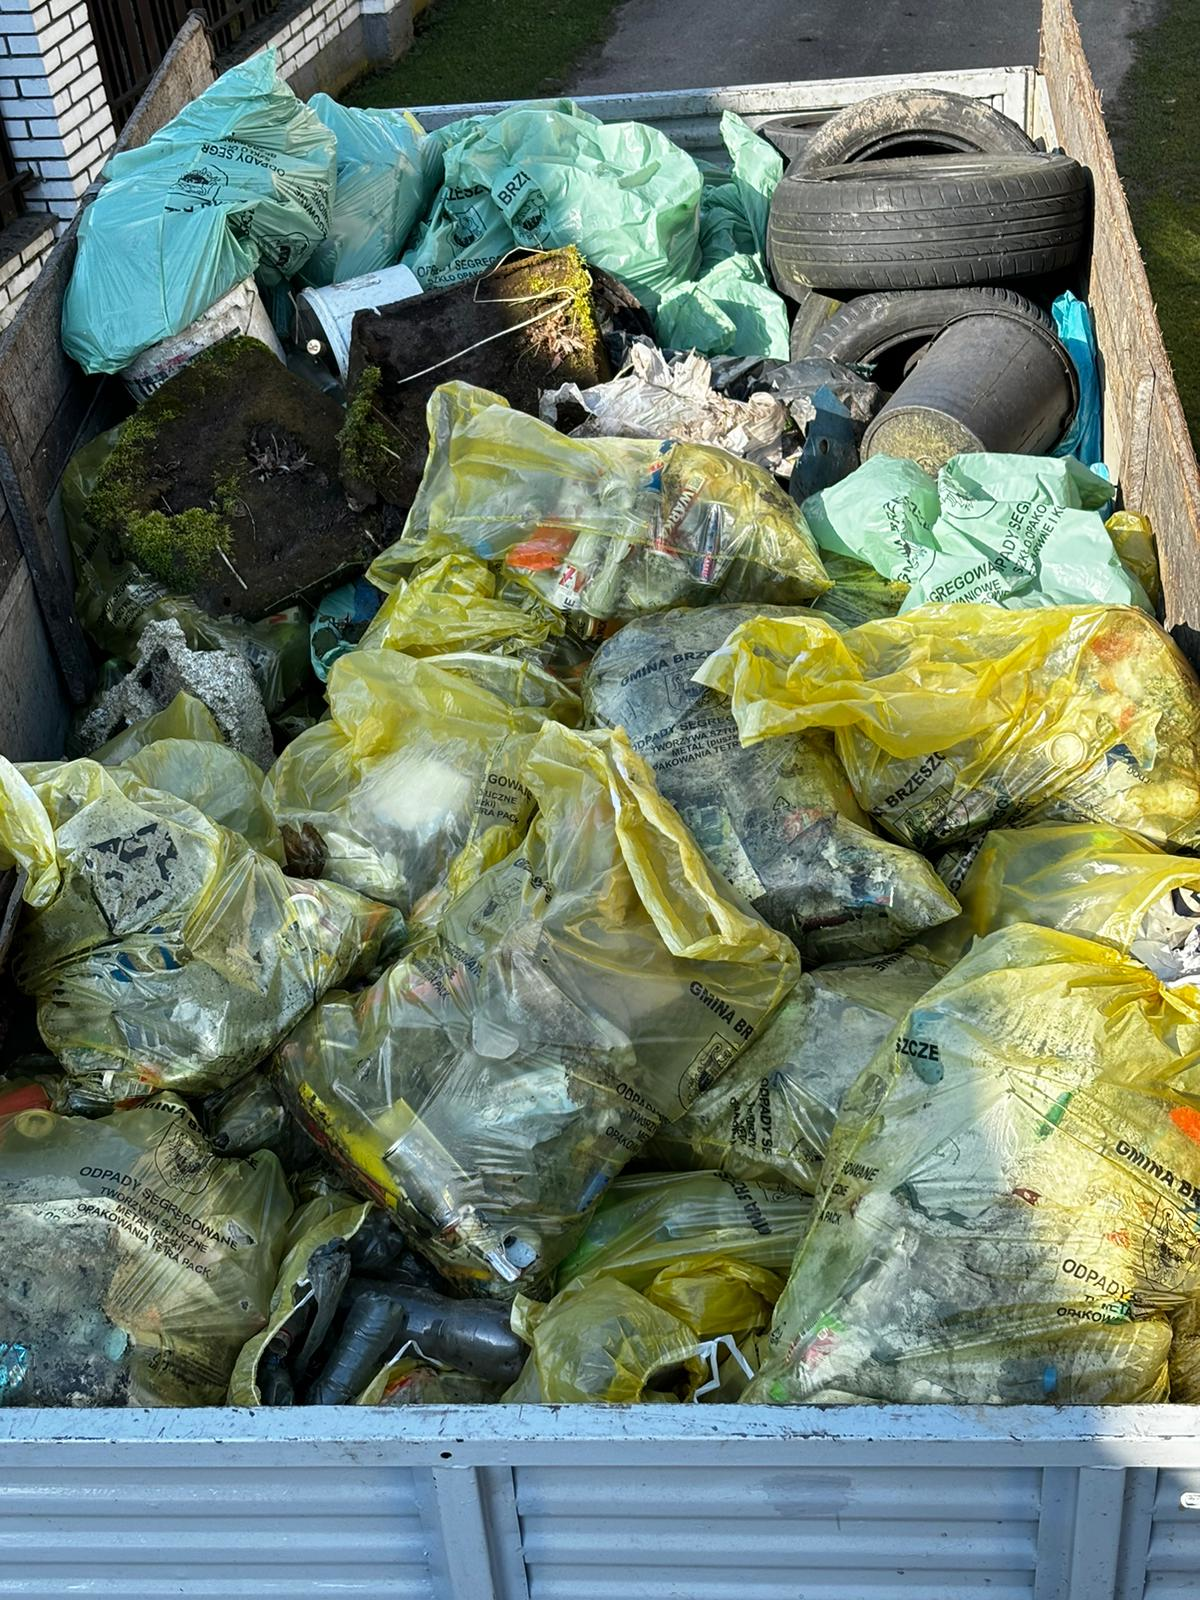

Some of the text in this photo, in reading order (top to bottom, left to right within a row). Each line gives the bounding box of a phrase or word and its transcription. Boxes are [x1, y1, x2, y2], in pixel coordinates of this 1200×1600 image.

[620, 659, 668, 688] GMINA
[671, 743, 705, 757] METAL
[1115, 1139, 1174, 1187] GMINA
[79, 1166, 239, 1252] ODPADY SEGREGOWANE
[100, 1186, 159, 1225] TWORZYWA
[115, 1204, 149, 1231] METAL
[77, 1203, 150, 1244] OPAKOWANIA
[152, 1238, 179, 1264] TETRA
[181, 1257, 212, 1279] PACK
